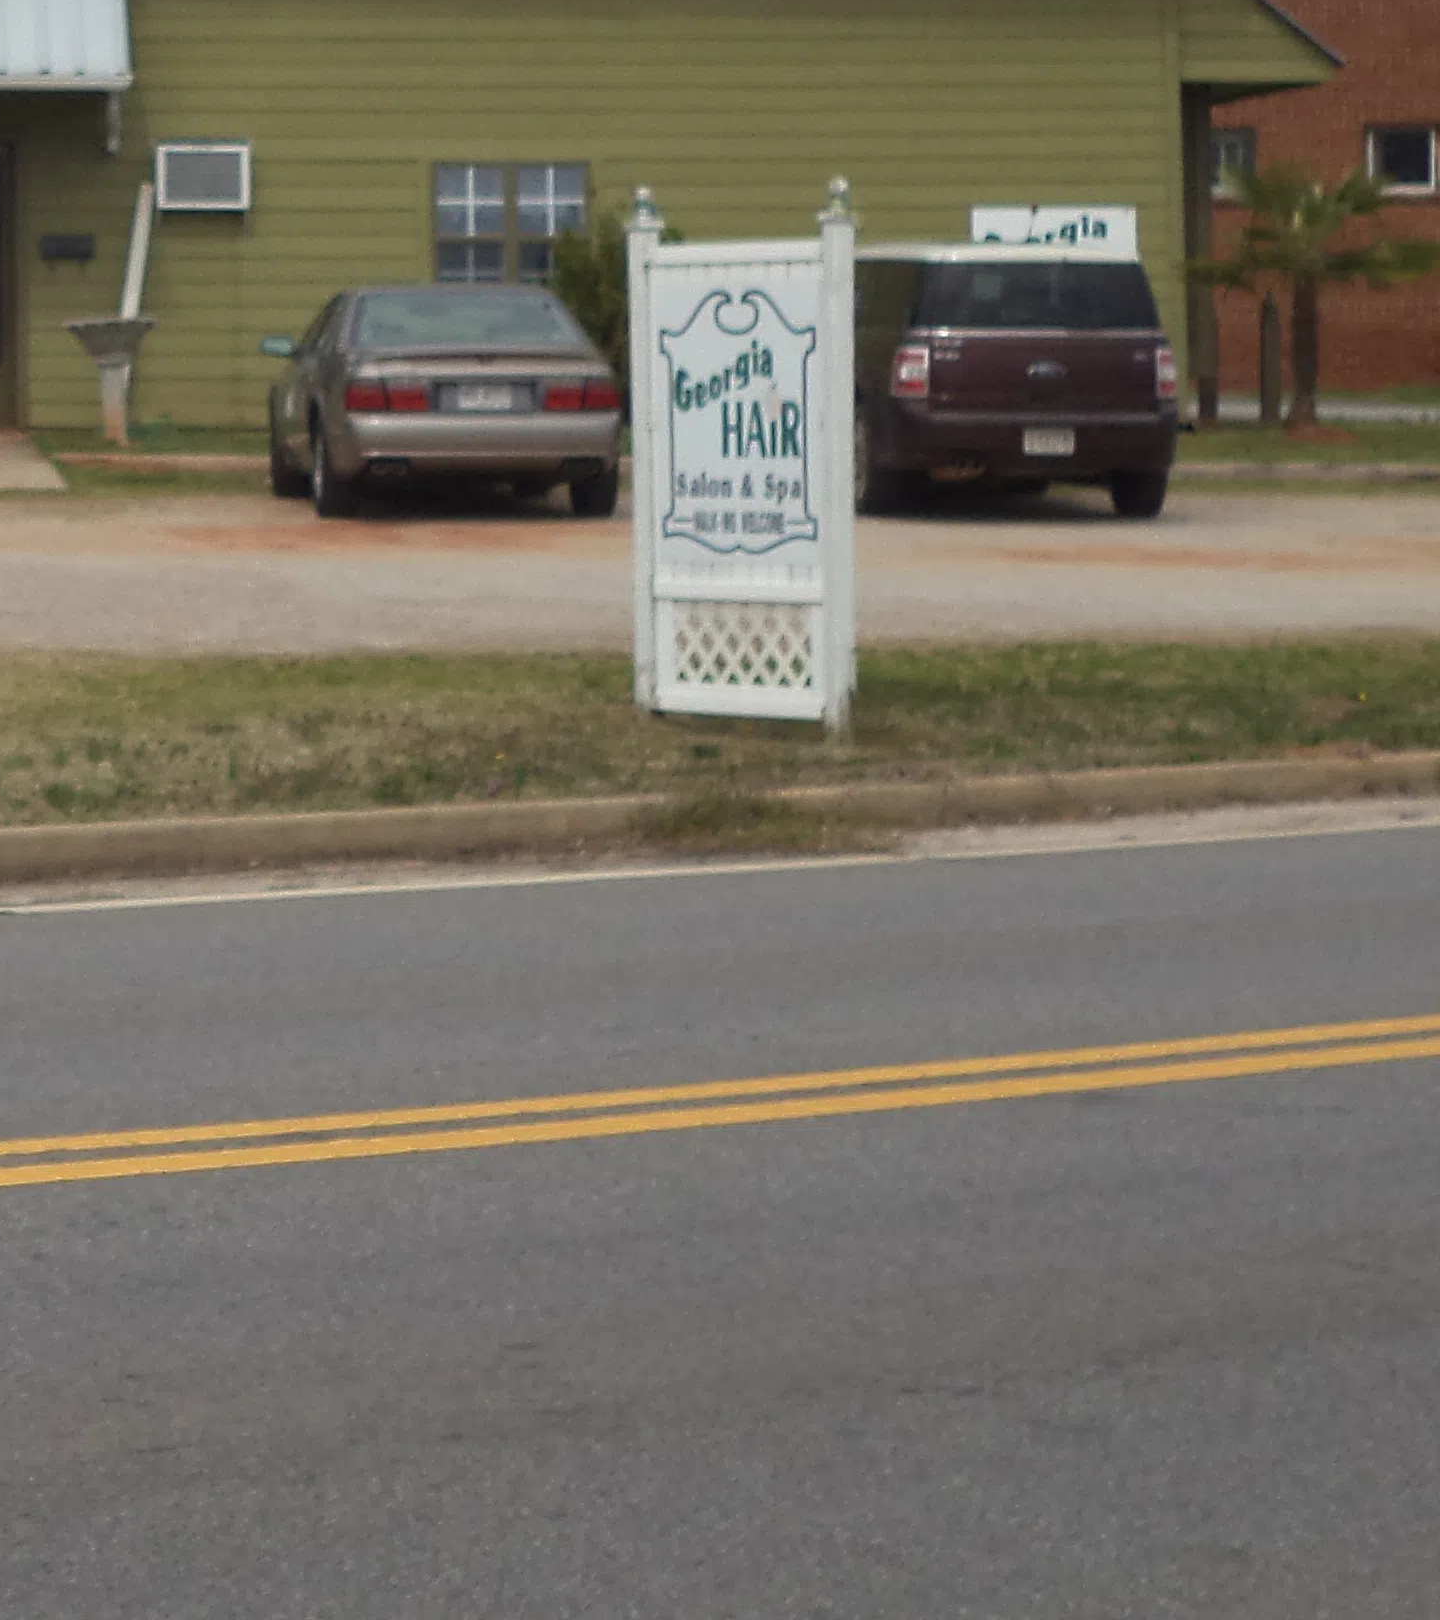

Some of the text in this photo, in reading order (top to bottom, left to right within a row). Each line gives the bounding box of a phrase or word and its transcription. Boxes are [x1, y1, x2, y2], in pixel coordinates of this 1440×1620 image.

[674, 340, 774, 412] Georgia
[675, 472, 803, 504] Salon & Spa
